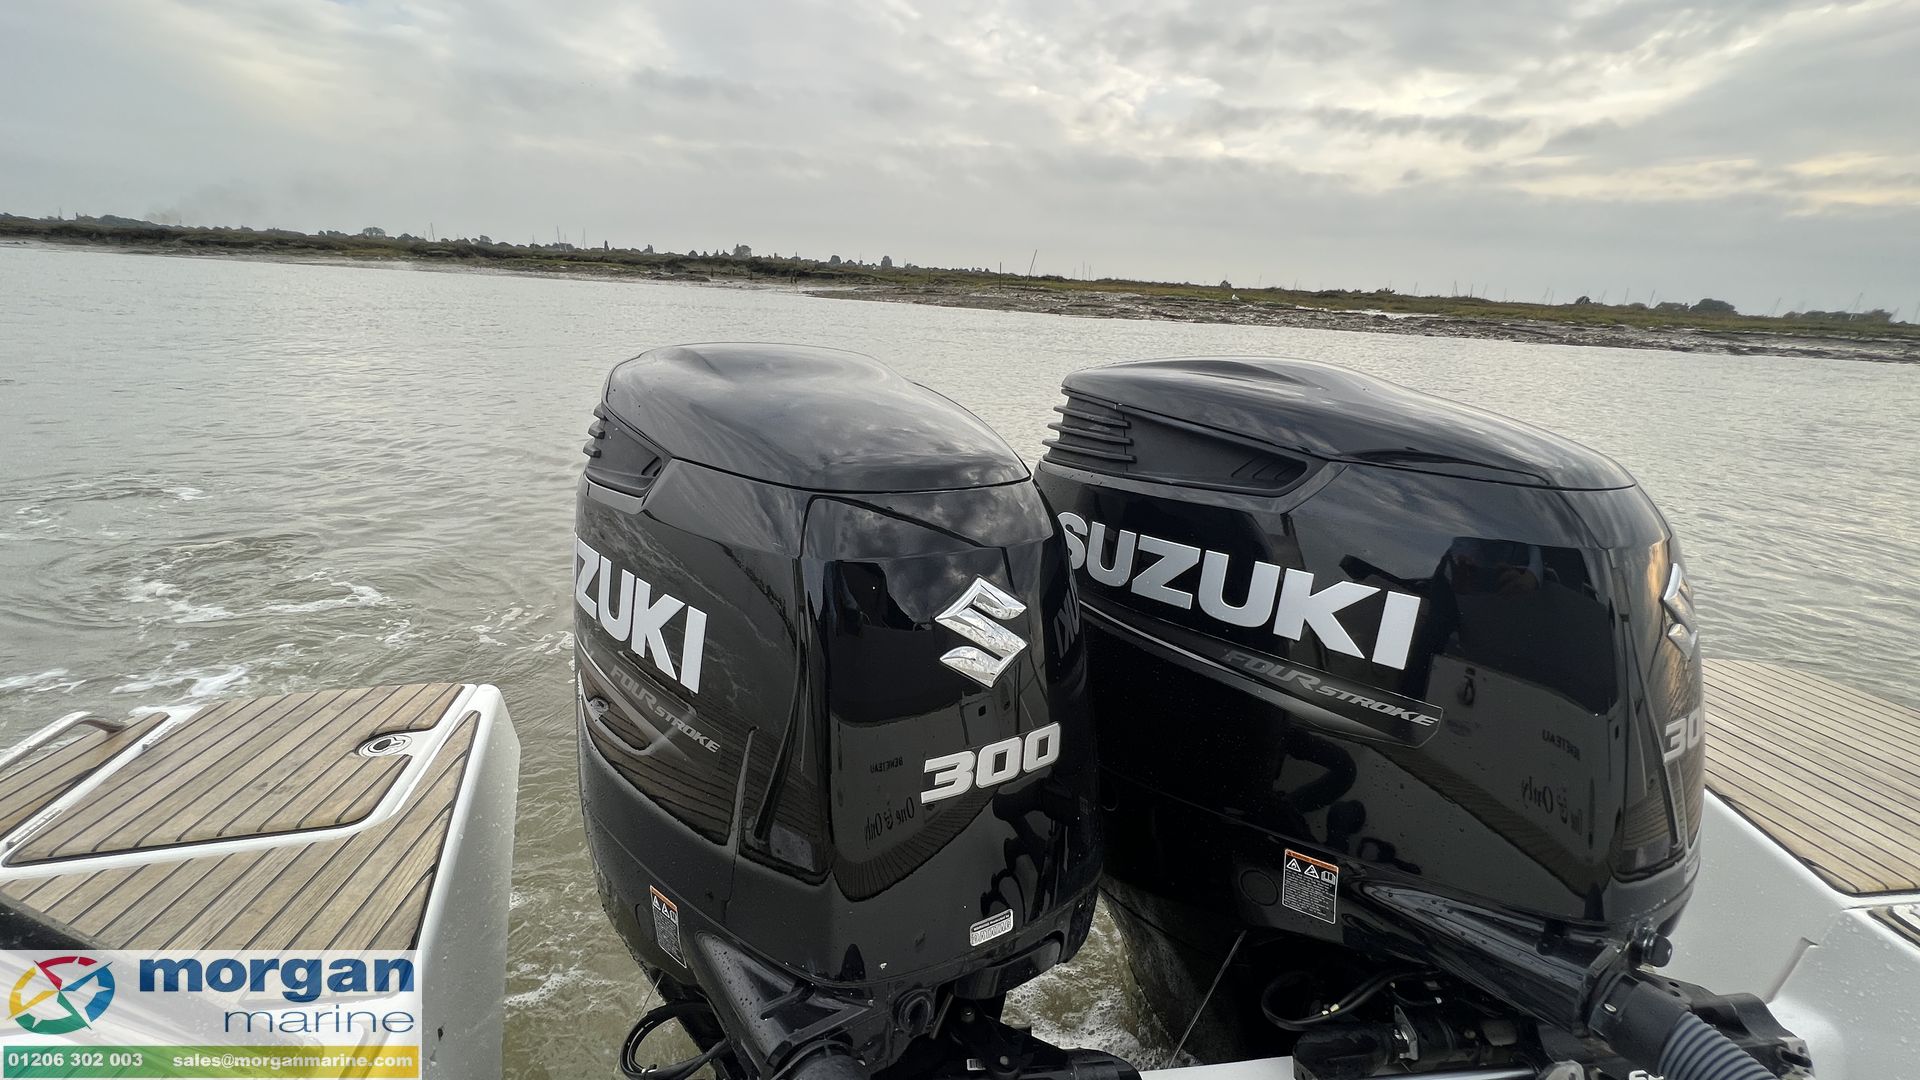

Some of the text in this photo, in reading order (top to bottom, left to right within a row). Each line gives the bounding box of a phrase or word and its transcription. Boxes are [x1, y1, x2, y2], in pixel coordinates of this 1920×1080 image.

[1057, 511, 1421, 670] SUZUKI
[610, 664, 721, 753] FOUR STROKE
[1220, 649, 1440, 727] FOUR STROKE
[921, 722, 1062, 805] 300
